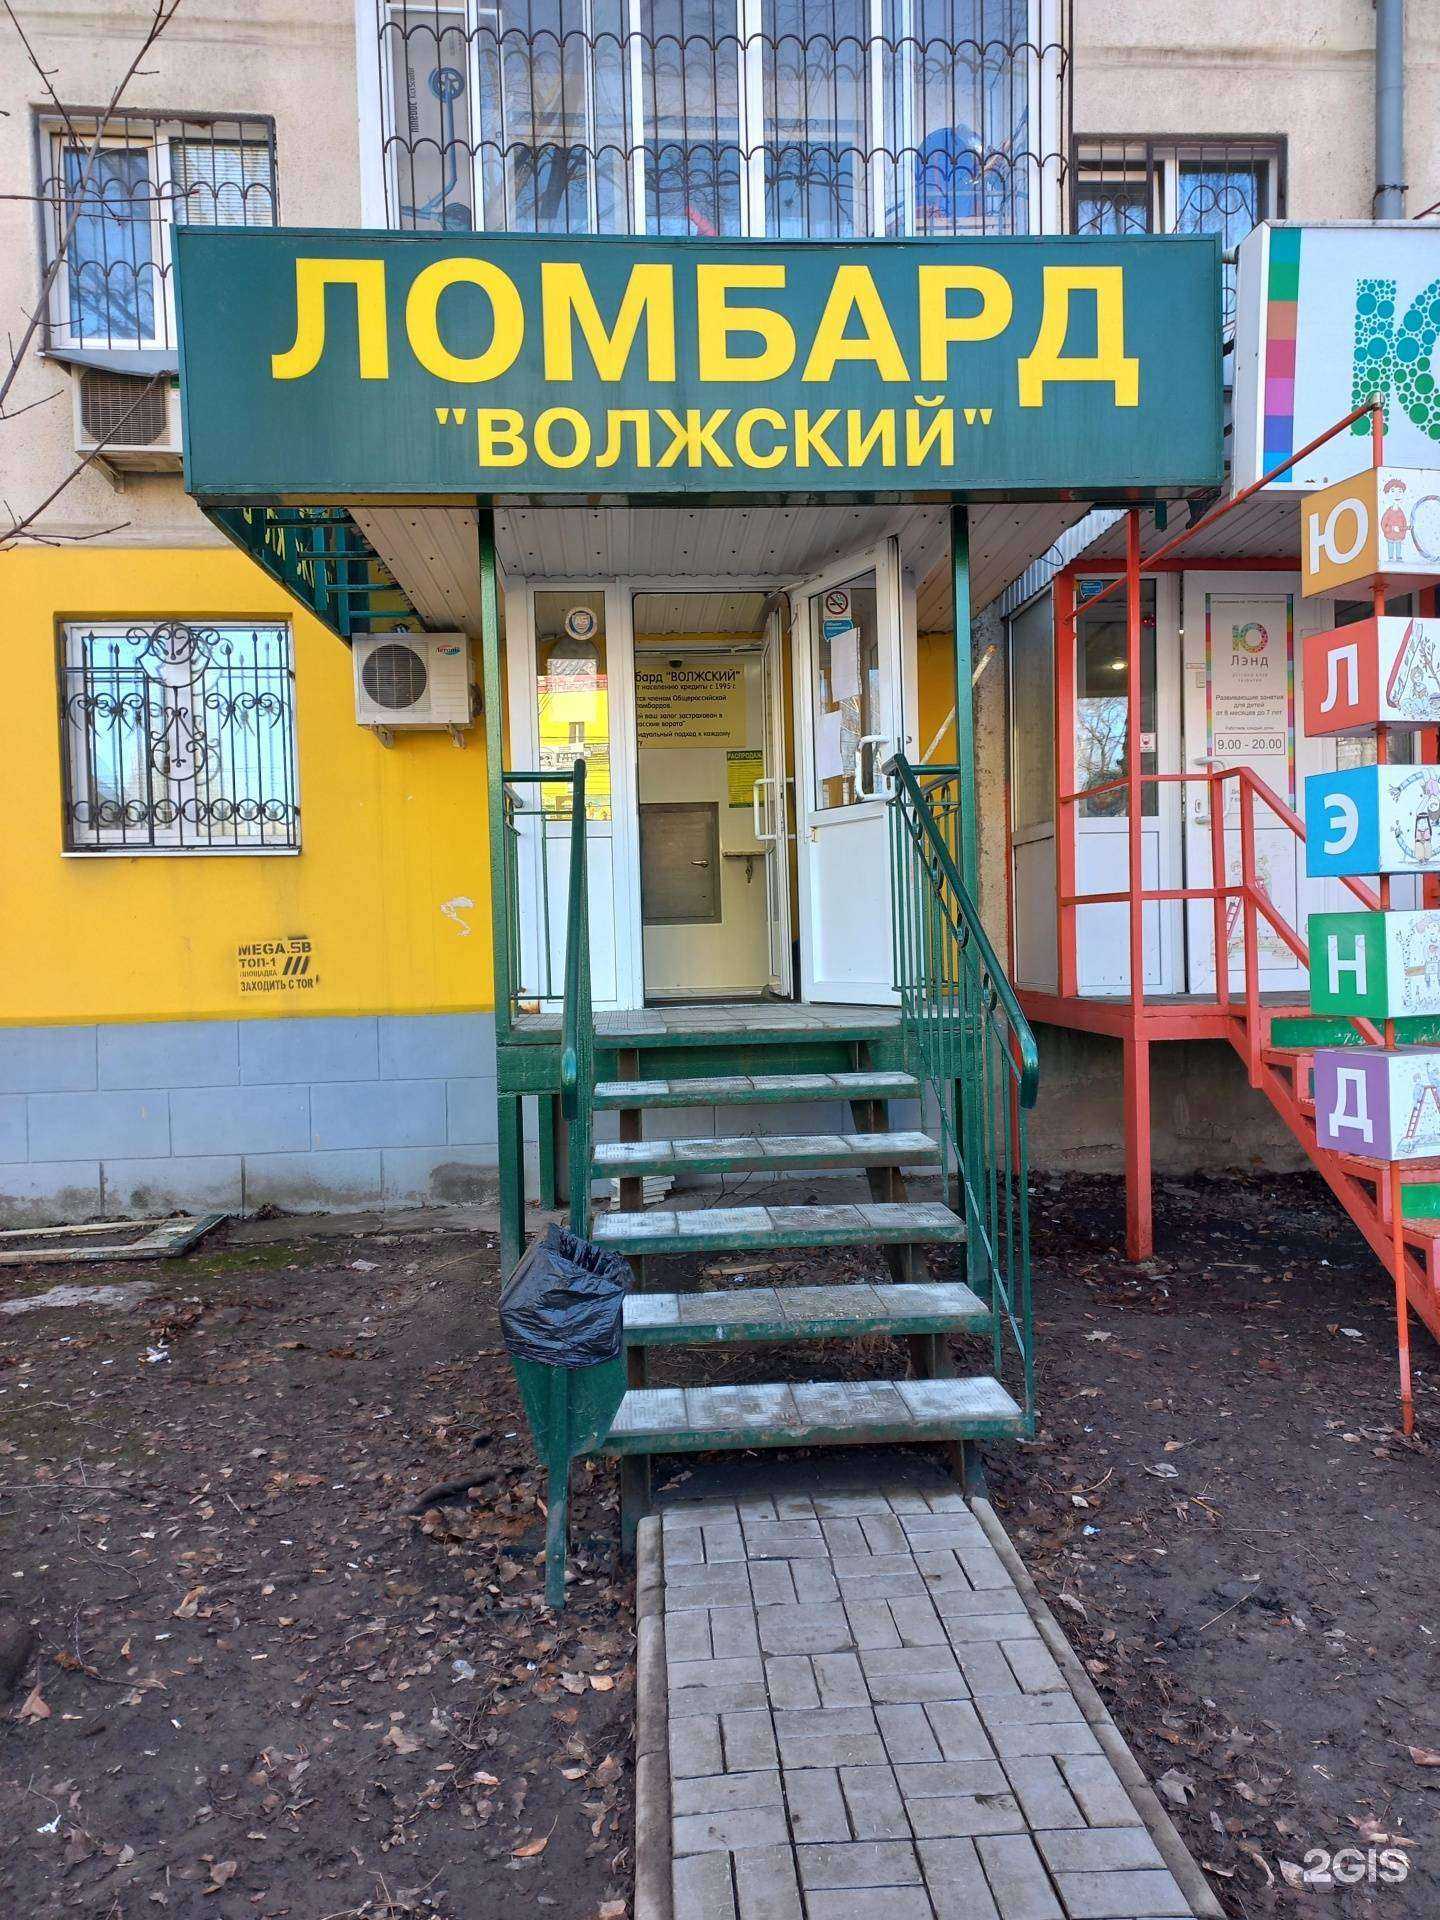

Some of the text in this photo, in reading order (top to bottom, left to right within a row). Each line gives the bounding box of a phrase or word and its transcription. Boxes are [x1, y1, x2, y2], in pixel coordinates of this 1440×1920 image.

[271, 257, 1139, 407] ЛОМБАРД
[437, 397, 992, 469] "ВОЛЖСКИЙ"
[1231, 654, 1269, 668] Лэнд
[666, 669, 741, 682] "ВОЛЖСКИЙ"
[672, 694, 727, 702] Общероссийской
[1217, 739, 1241, 750] 9.00
[1252, 739, 1282, 749] 20.00
[240, 980, 286, 992] ЗАХОДИТЬ
[296, 978, 314, 989] TOR
